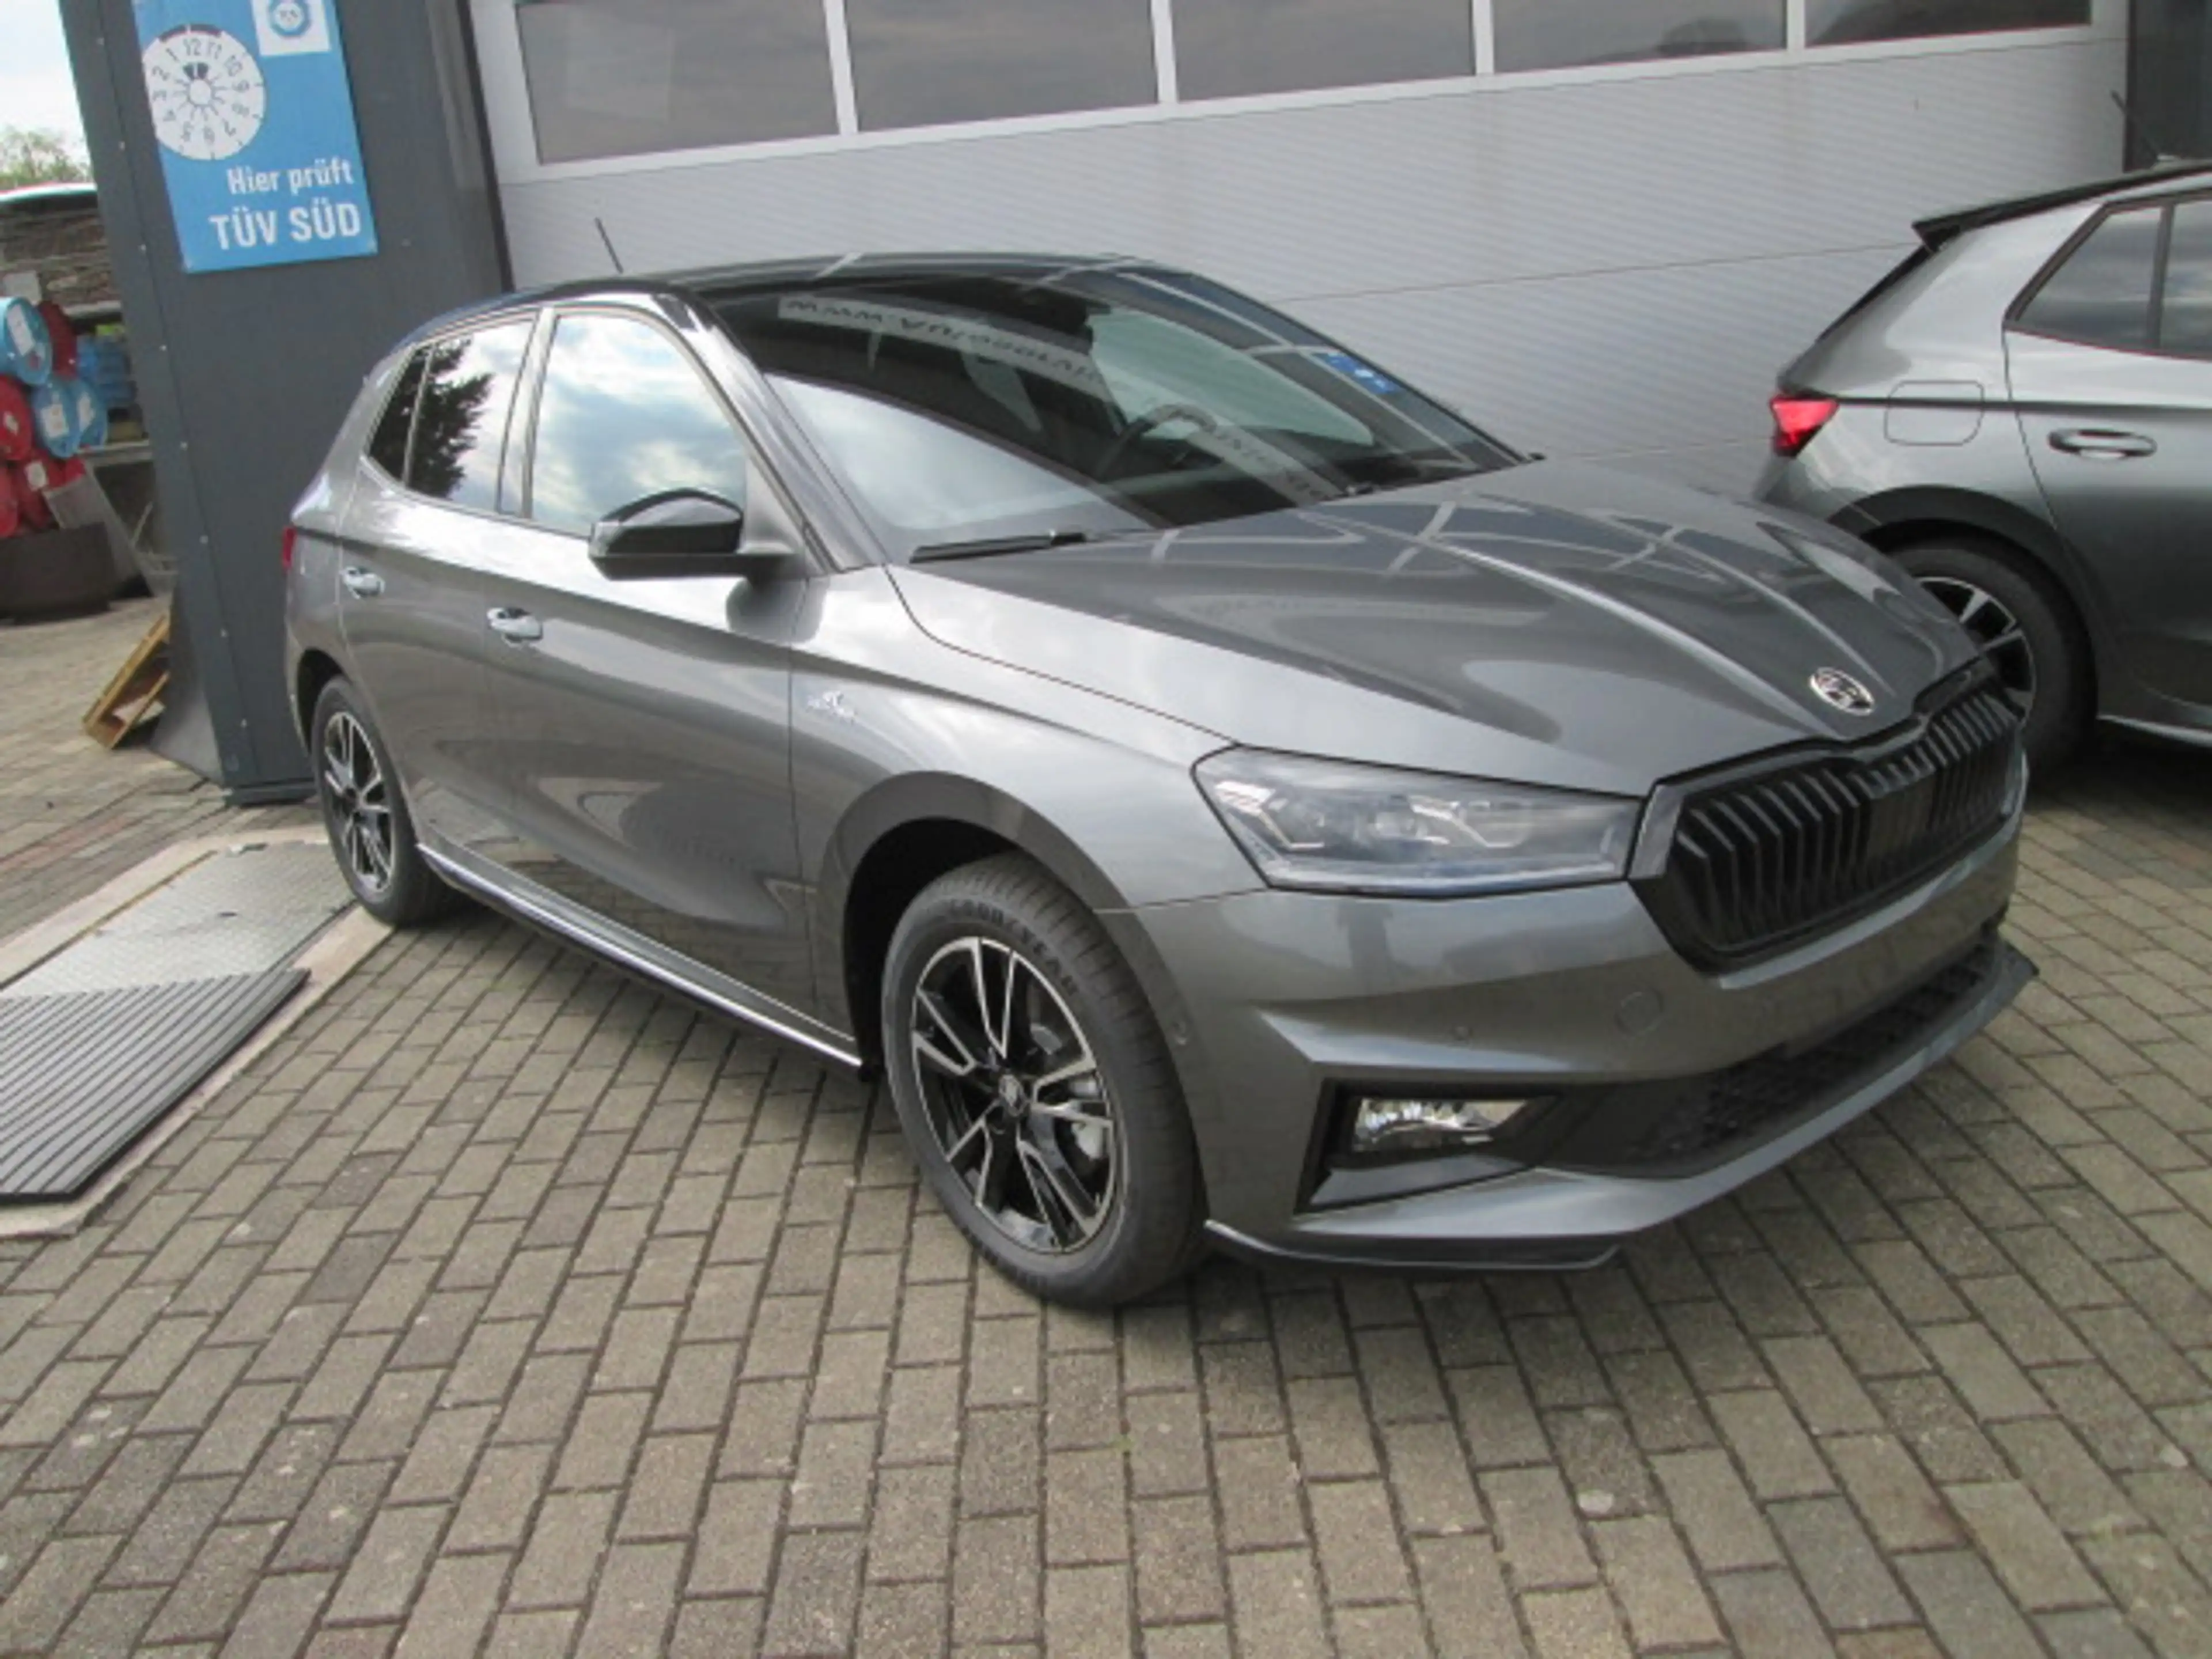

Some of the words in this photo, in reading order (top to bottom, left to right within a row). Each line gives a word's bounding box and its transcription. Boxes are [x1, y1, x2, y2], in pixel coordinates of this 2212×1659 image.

[226, 165, 279, 195] Hier
[289, 156, 354, 196] prüft
[208, 204, 277, 251] TÜV
[289, 196, 361, 243] SÜD
